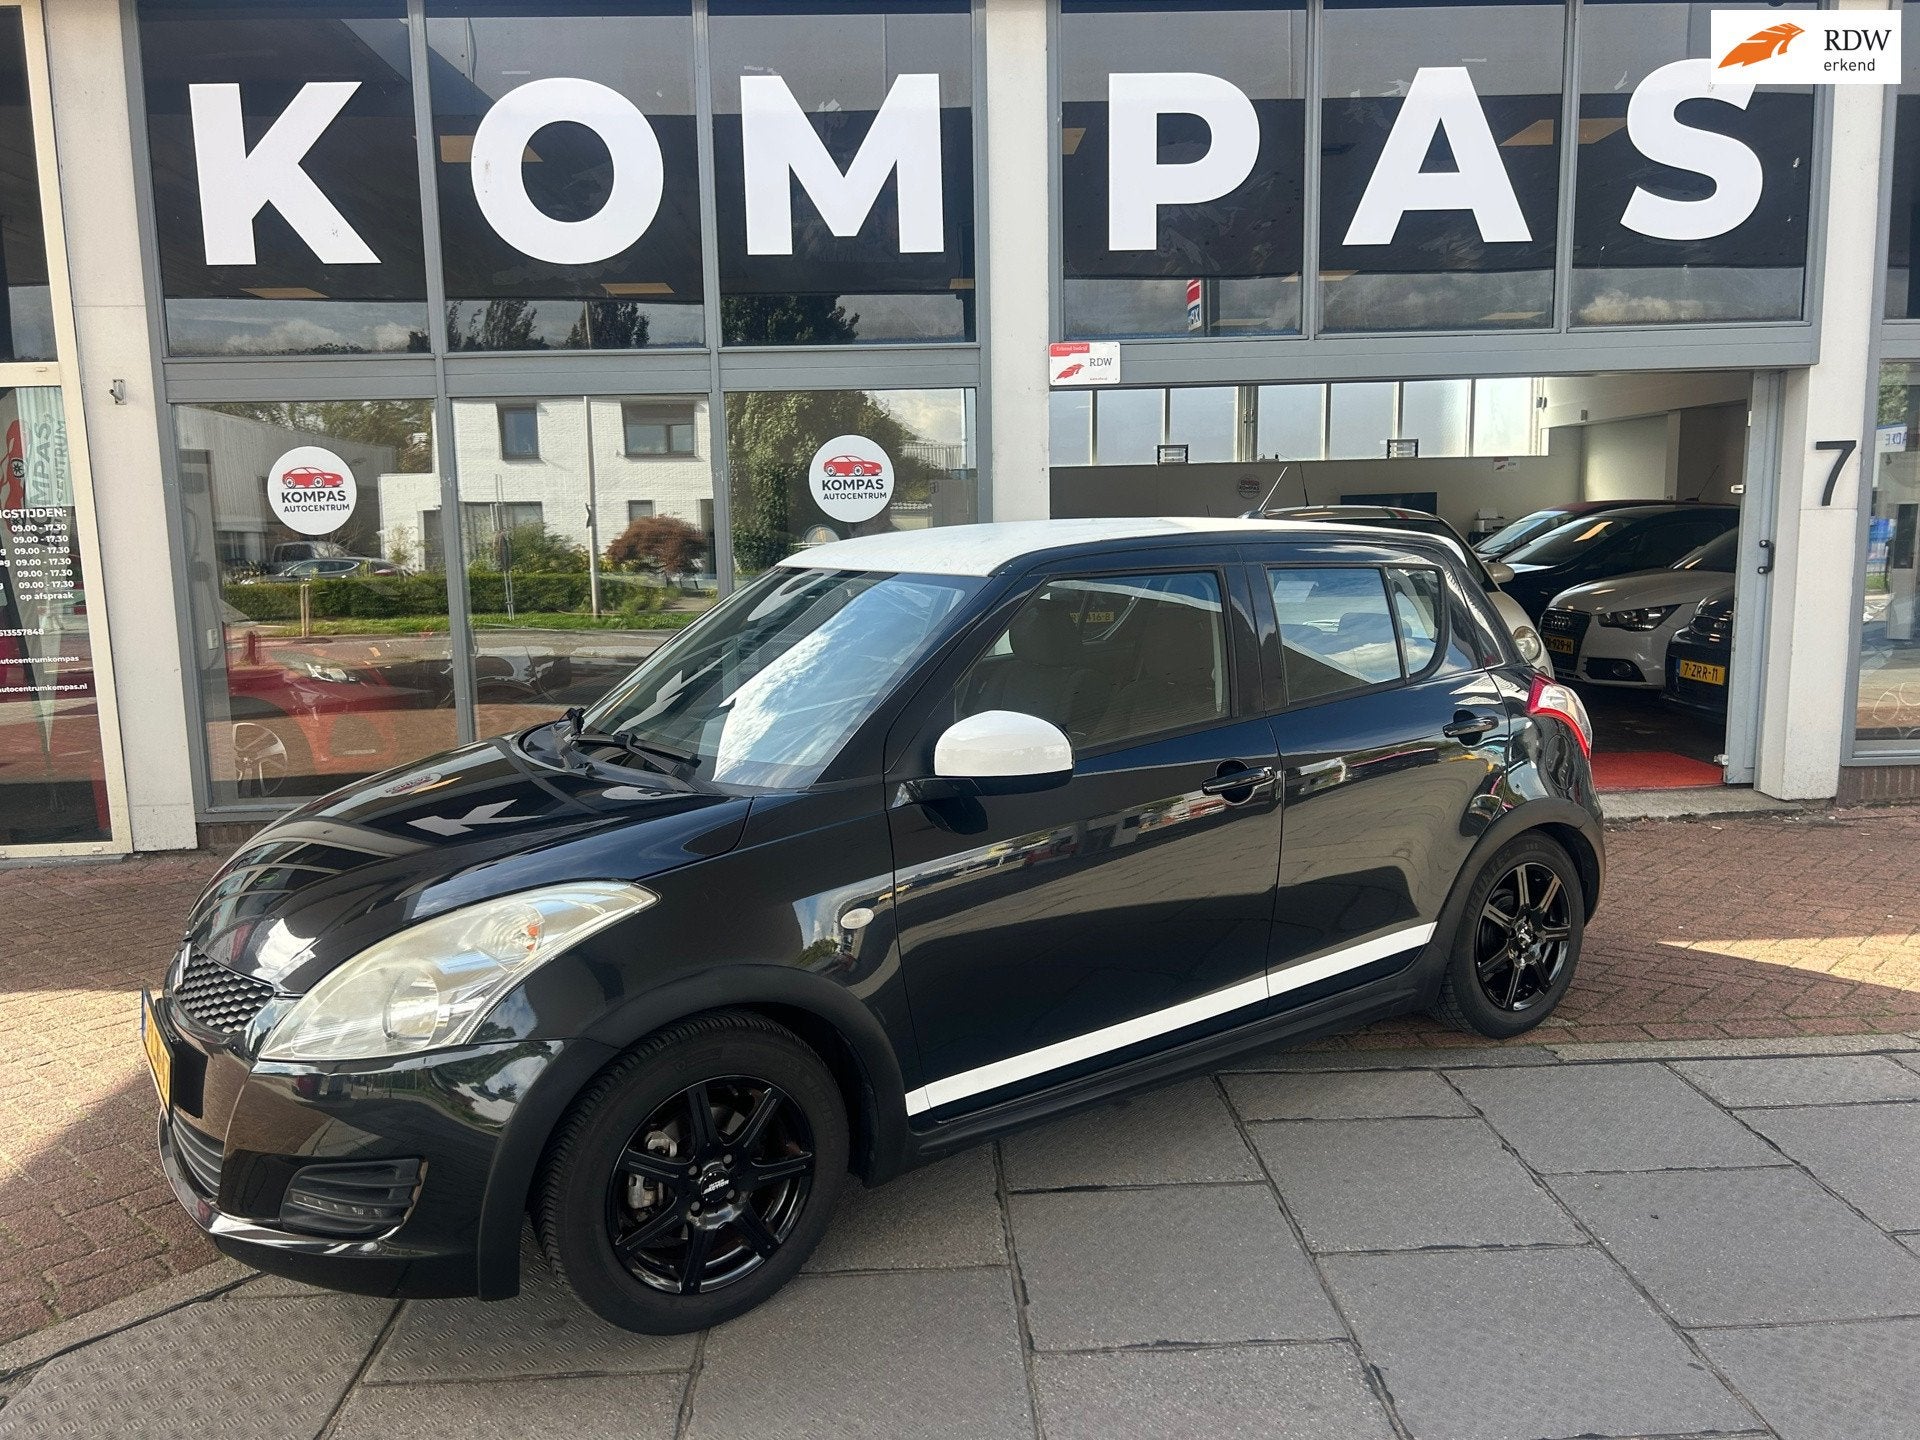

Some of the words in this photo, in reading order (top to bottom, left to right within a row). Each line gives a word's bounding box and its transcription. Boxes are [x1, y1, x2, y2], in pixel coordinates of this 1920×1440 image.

[189, 58, 1764, 266] KOMPAS
[1089, 357, 1113, 367] RDW
[1815, 440, 1857, 506] 7
[822, 479, 884, 491] KOMPAS
[281, 490, 346, 503] KOMPAS
[823, 492, 887, 500] AUTOCENTRUM
[0, 508, 67, 519] GSTIJDEN:
[284, 504, 350, 513] AUTOCENTRUM
[11, 524, 37, 533] 09.00
[44, 523, 67, 531] 17.30
[13, 536, 39, 544] 09.00
[46, 535, 69, 543] 17.30
[14, 547, 40, 555] 09.00
[47, 546, 70, 554] 17.30
[15, 559, 41, 567] 09.00
[49, 558, 72, 566] 17.30
[17, 570, 43, 578] 09.00
[50, 569, 73, 577] 17.30
[18, 581, 44, 589] 09.00
[51, 580, 75, 588] 17.30
[20, 594, 32, 602] op
[34, 591, 75, 601] afspraak
[1684, 662, 1719, 681] 7-ZRR-11
